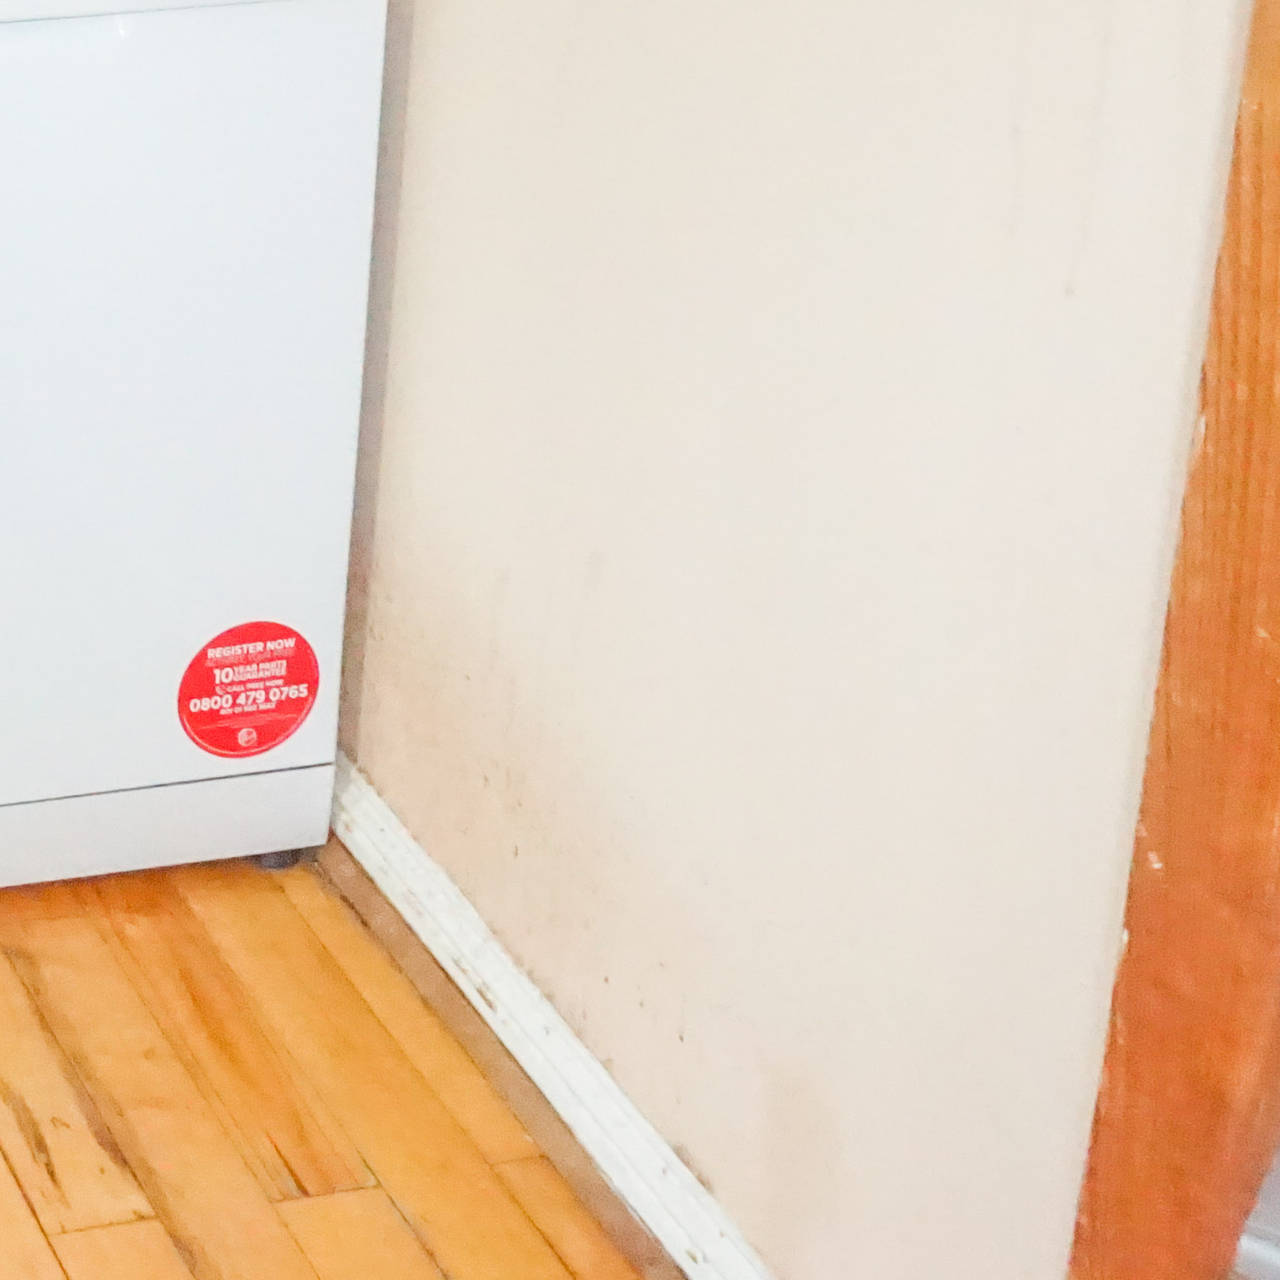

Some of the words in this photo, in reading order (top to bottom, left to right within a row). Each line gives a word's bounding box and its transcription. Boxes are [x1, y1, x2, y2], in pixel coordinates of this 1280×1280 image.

[207, 642, 264, 659] REGISTER
[266, 637, 297, 652] NOW
[213, 667, 234, 685] 10
[189, 694, 233, 713] 0800
[236, 690, 266, 706] 479
[269, 683, 309, 702] 0765
